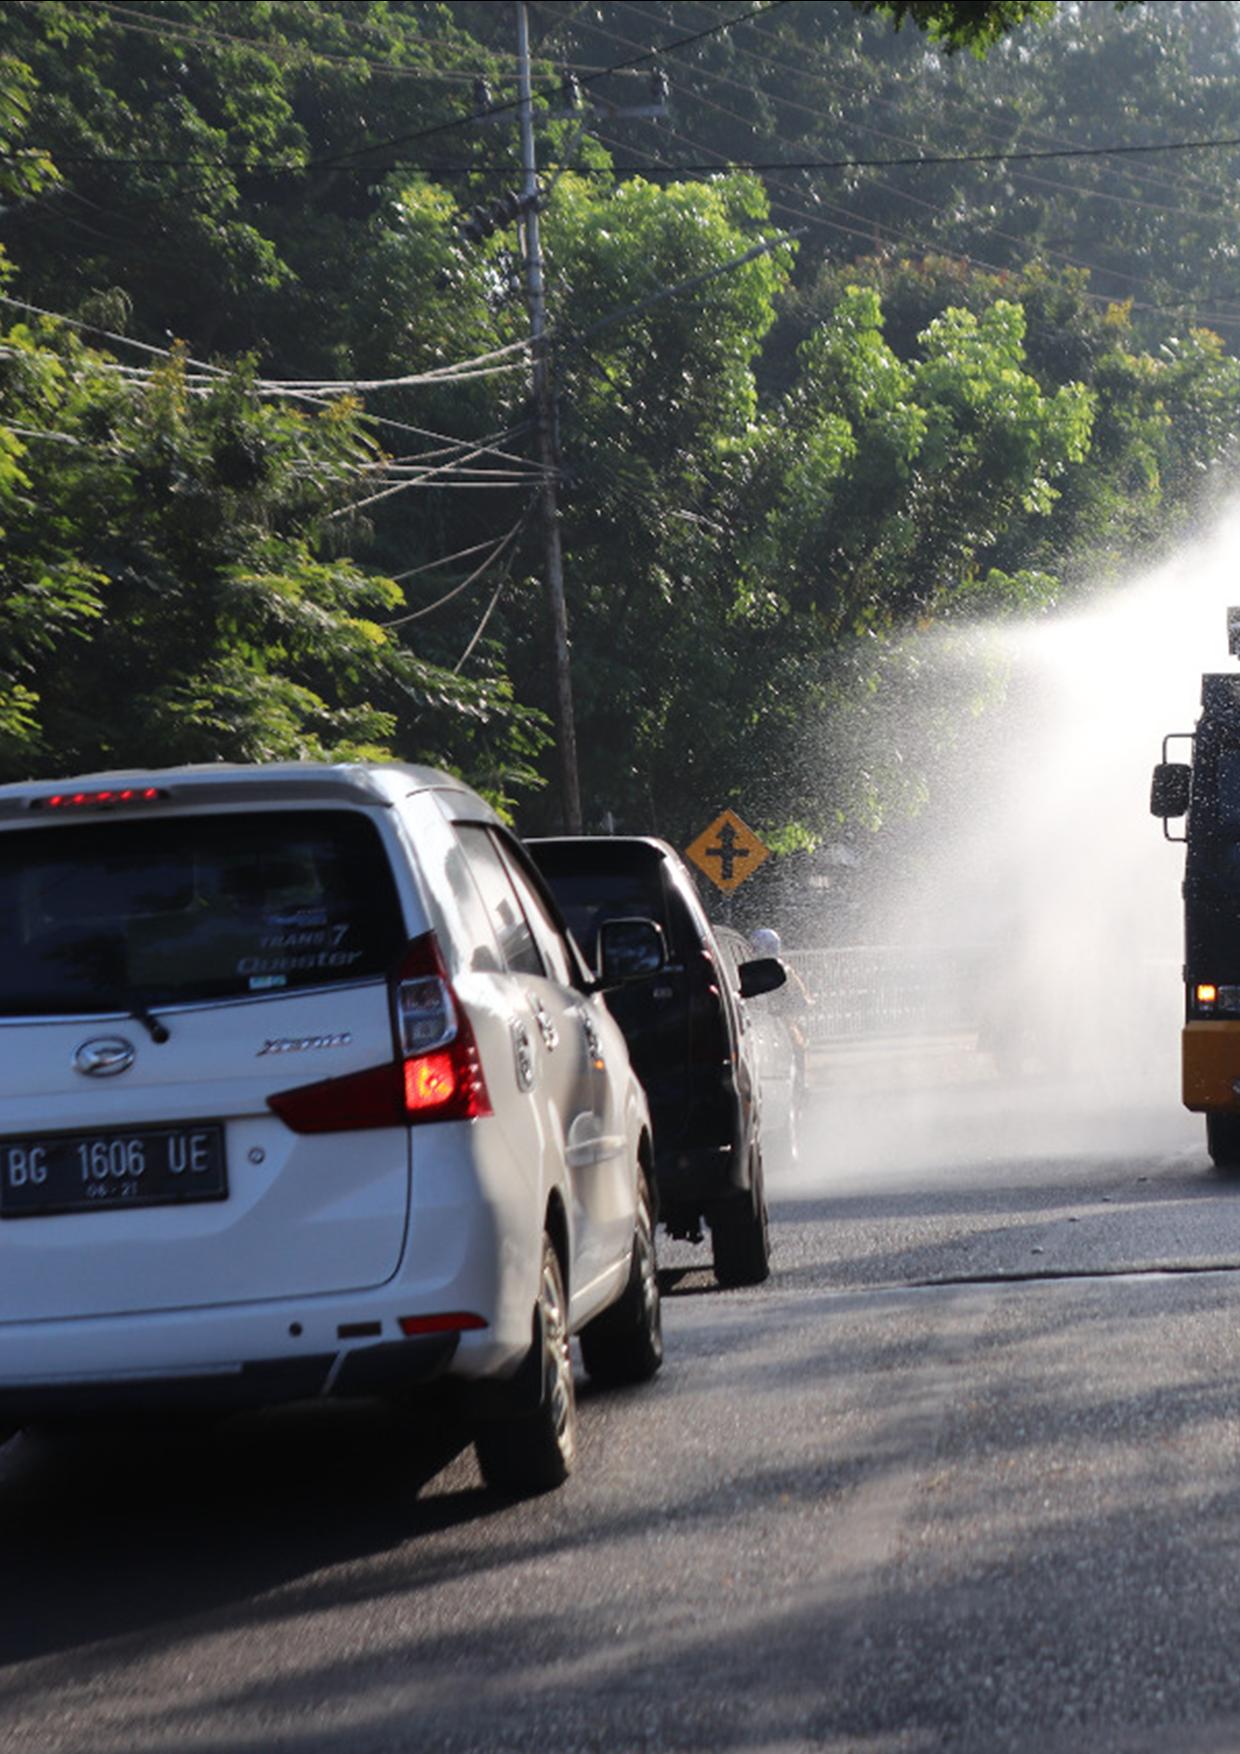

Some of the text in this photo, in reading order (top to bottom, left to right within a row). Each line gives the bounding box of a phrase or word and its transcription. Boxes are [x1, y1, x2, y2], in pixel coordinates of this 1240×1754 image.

[8, 1134, 208, 1187] BG 1606 UE
